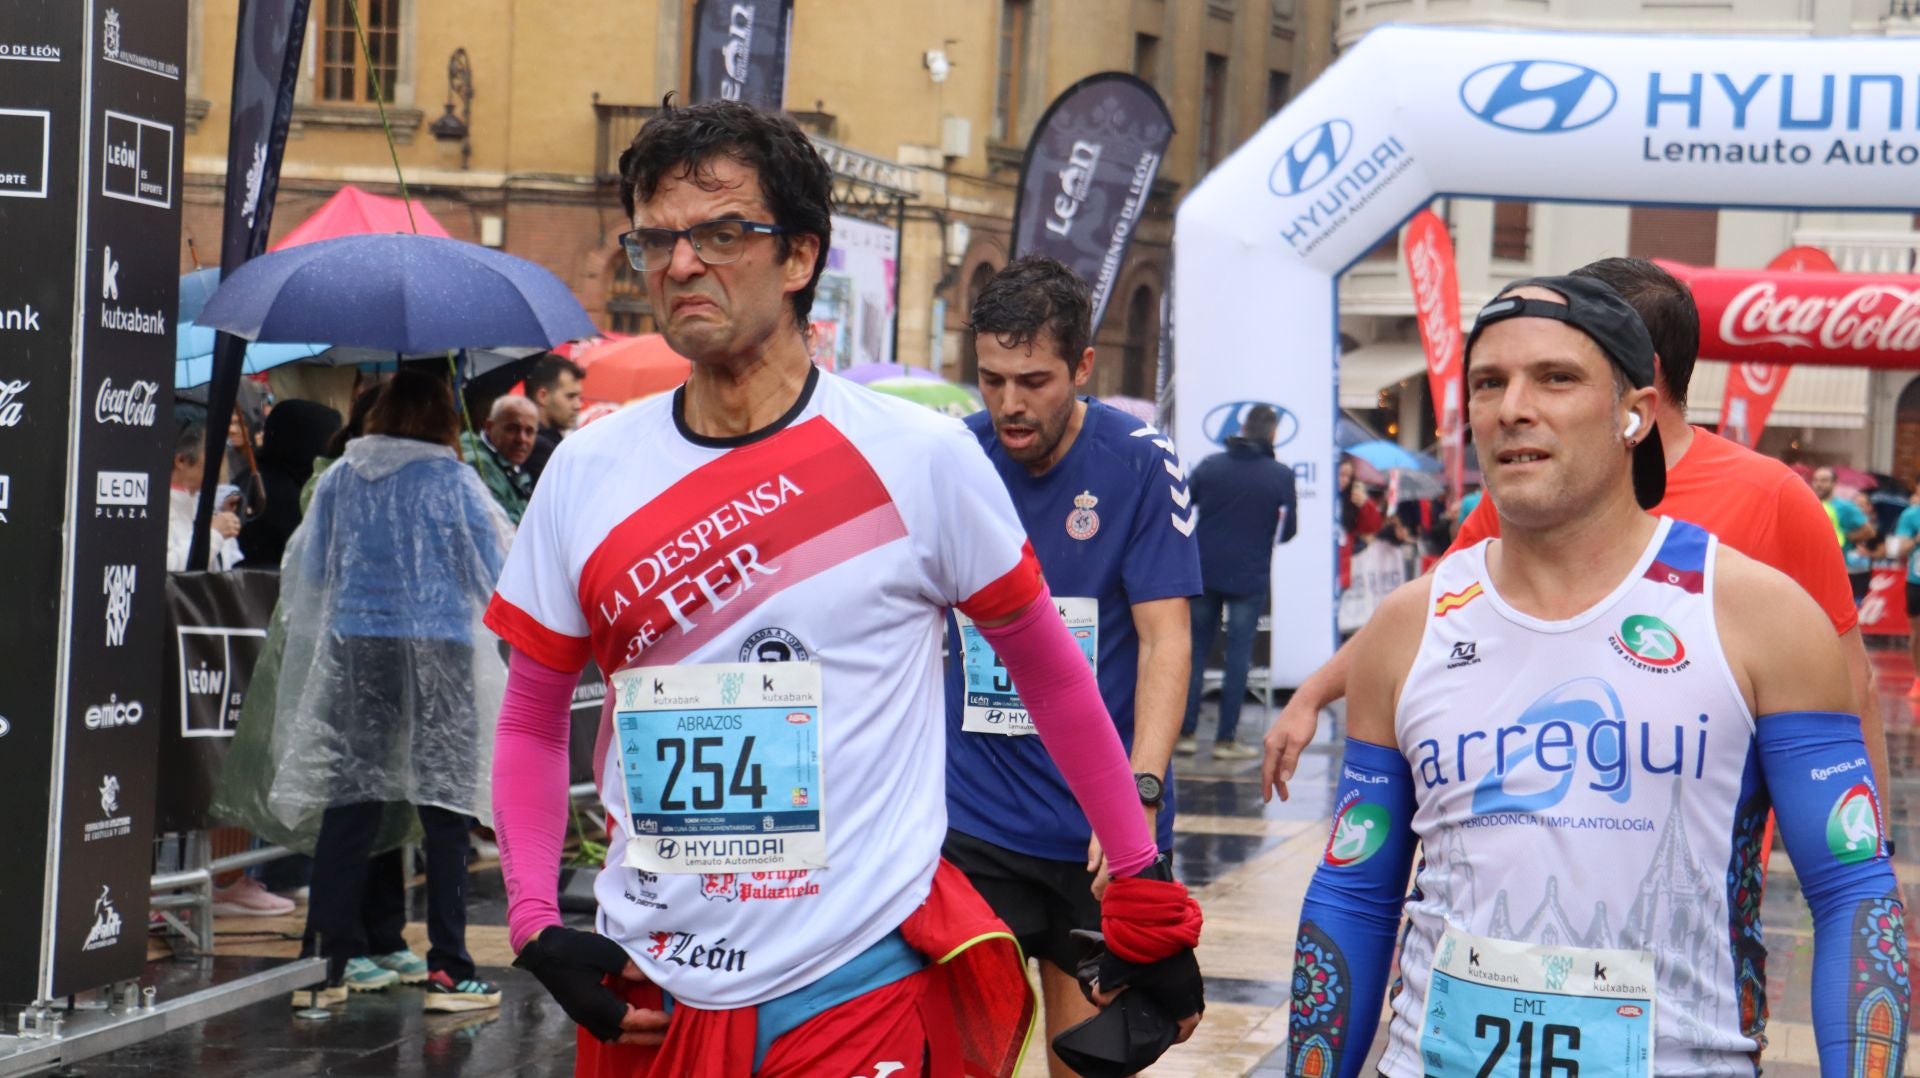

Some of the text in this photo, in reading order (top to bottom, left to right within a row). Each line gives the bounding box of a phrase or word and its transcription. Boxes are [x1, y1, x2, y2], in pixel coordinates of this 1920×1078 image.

[12, 45, 28, 56] DE
[30, 44, 61, 57] LEÓN
[1644, 71, 1920, 131] HYUN
[107, 141, 137, 169] LEÓN
[1642, 136, 1920, 166] Lemauto Auto
[140, 169, 149, 180] ES
[139, 181, 164, 197] DEPORTE
[1280, 135, 1406, 248] HYUNDAI
[1119, 196, 1138, 220] DE
[1298, 214, 1348, 258] Lemauto
[101, 302, 166, 336] kutxabank
[1719, 281, 1920, 350] Coca-Cola
[95, 376, 160, 427] Coca-Cola
[95, 507, 148, 519] PLAZA
[599, 473, 805, 627] LA DESPENSA
[103, 564, 137, 595] KAM
[655, 542, 782, 636] FER
[187, 660, 224, 695] LEÓN
[231, 692, 242, 705] ES
[653, 695, 700, 705] kutxabank
[762, 692, 814, 702] kutxabank
[85, 692, 143, 731] emico
[677, 714, 743, 732] ABRAZOS
[1418, 713, 1709, 793] arregui
[656, 735, 768, 812] 254
[1810, 757, 1868, 781] MAGLIA
[1457, 813, 1541, 830] PERIODONCIA
[1546, 814, 1656, 833] IMPLANTOLOGÍA
[685, 838, 784, 857] HYUNDAI
[685, 855, 785, 867] Lemauto Automoción
[739, 881, 820, 902] Palazuelo
[665, 931, 749, 973] León
[1469, 946, 1480, 966] k
[1467, 966, 1520, 984] kutxabank
[1594, 960, 1607, 981] k
[1592, 981, 1648, 994] kutxabank
[1512, 997, 1547, 1017] EMI
[1474, 1013, 1581, 1078] 216
